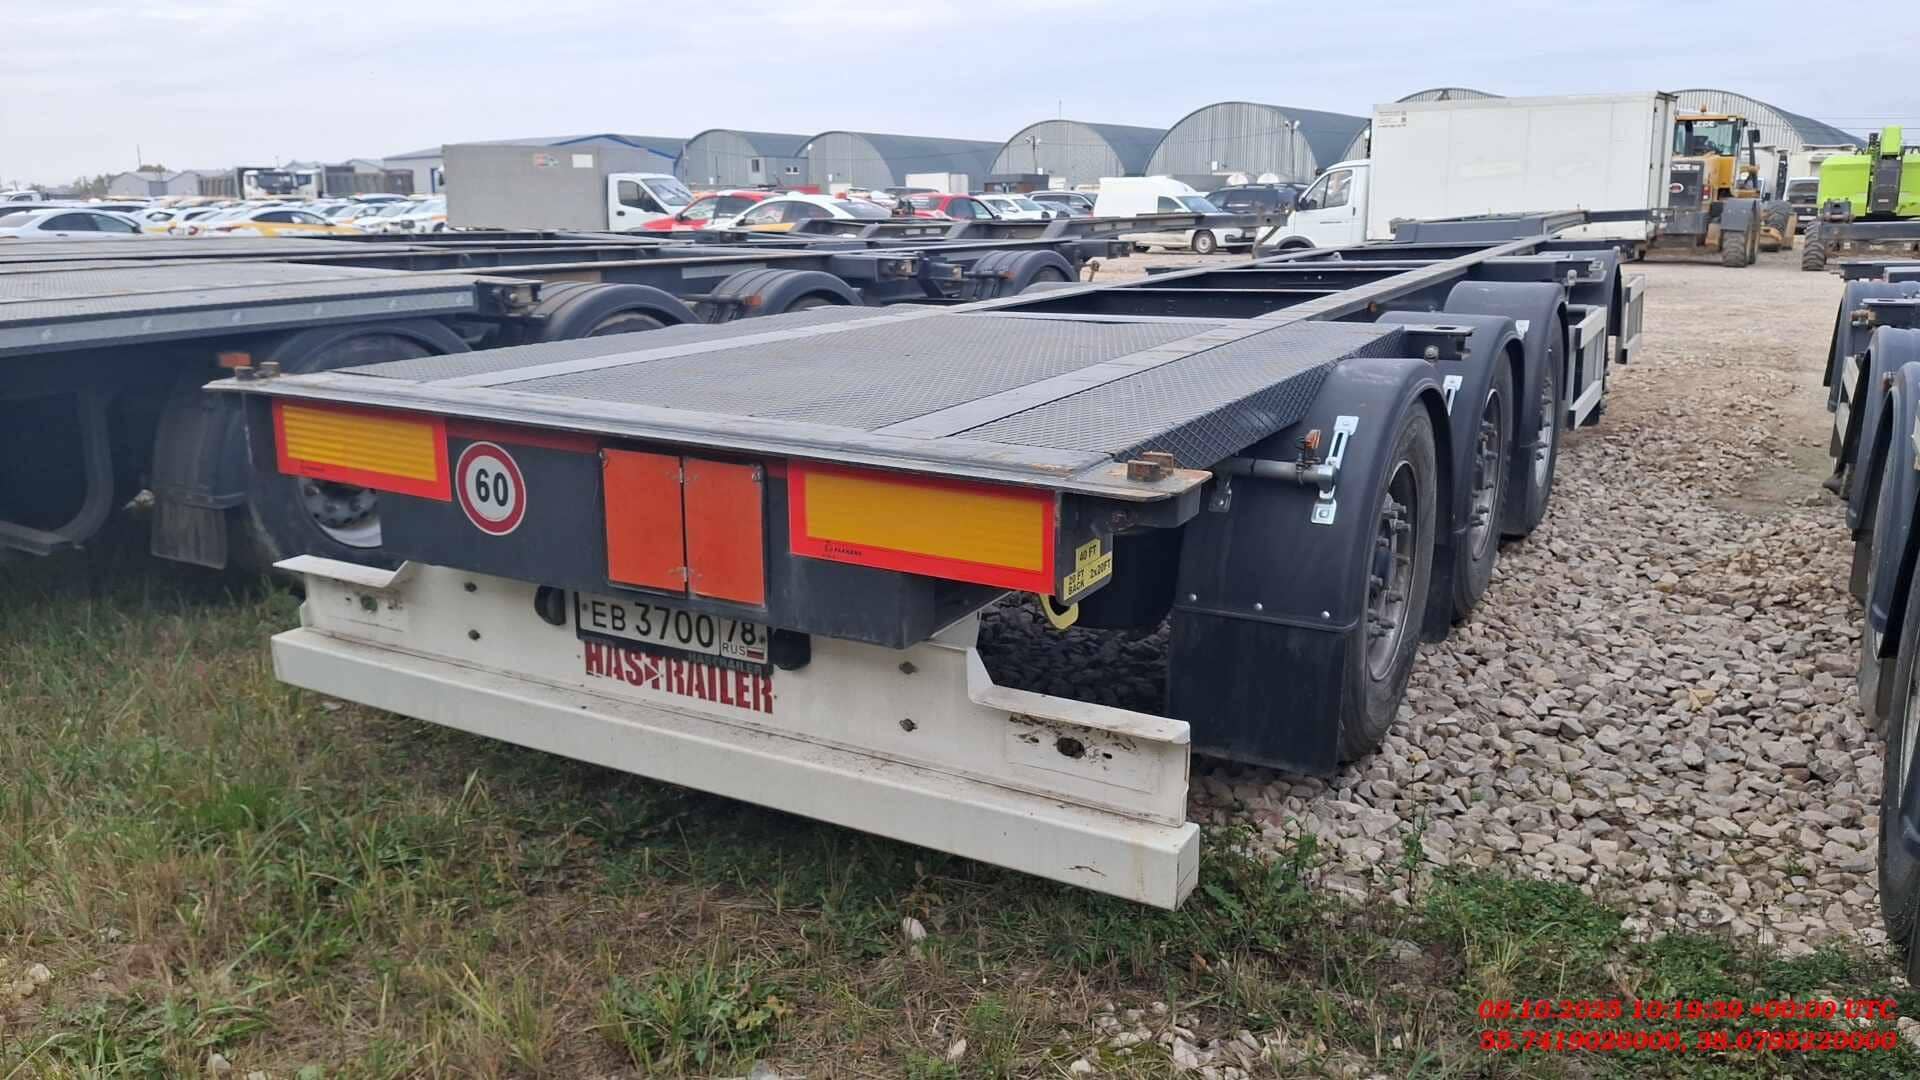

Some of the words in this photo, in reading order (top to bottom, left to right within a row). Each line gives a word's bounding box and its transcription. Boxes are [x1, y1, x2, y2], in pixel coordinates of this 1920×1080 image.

[476, 468, 508, 506] 60
[1089, 544, 1097, 558] FT
[1078, 568, 1085, 580] FT
[1068, 580, 1085, 595] BACK
[634, 601, 714, 648] 3700
[722, 642, 746, 656] RUS
[585, 641, 773, 713] HASTRAILER
